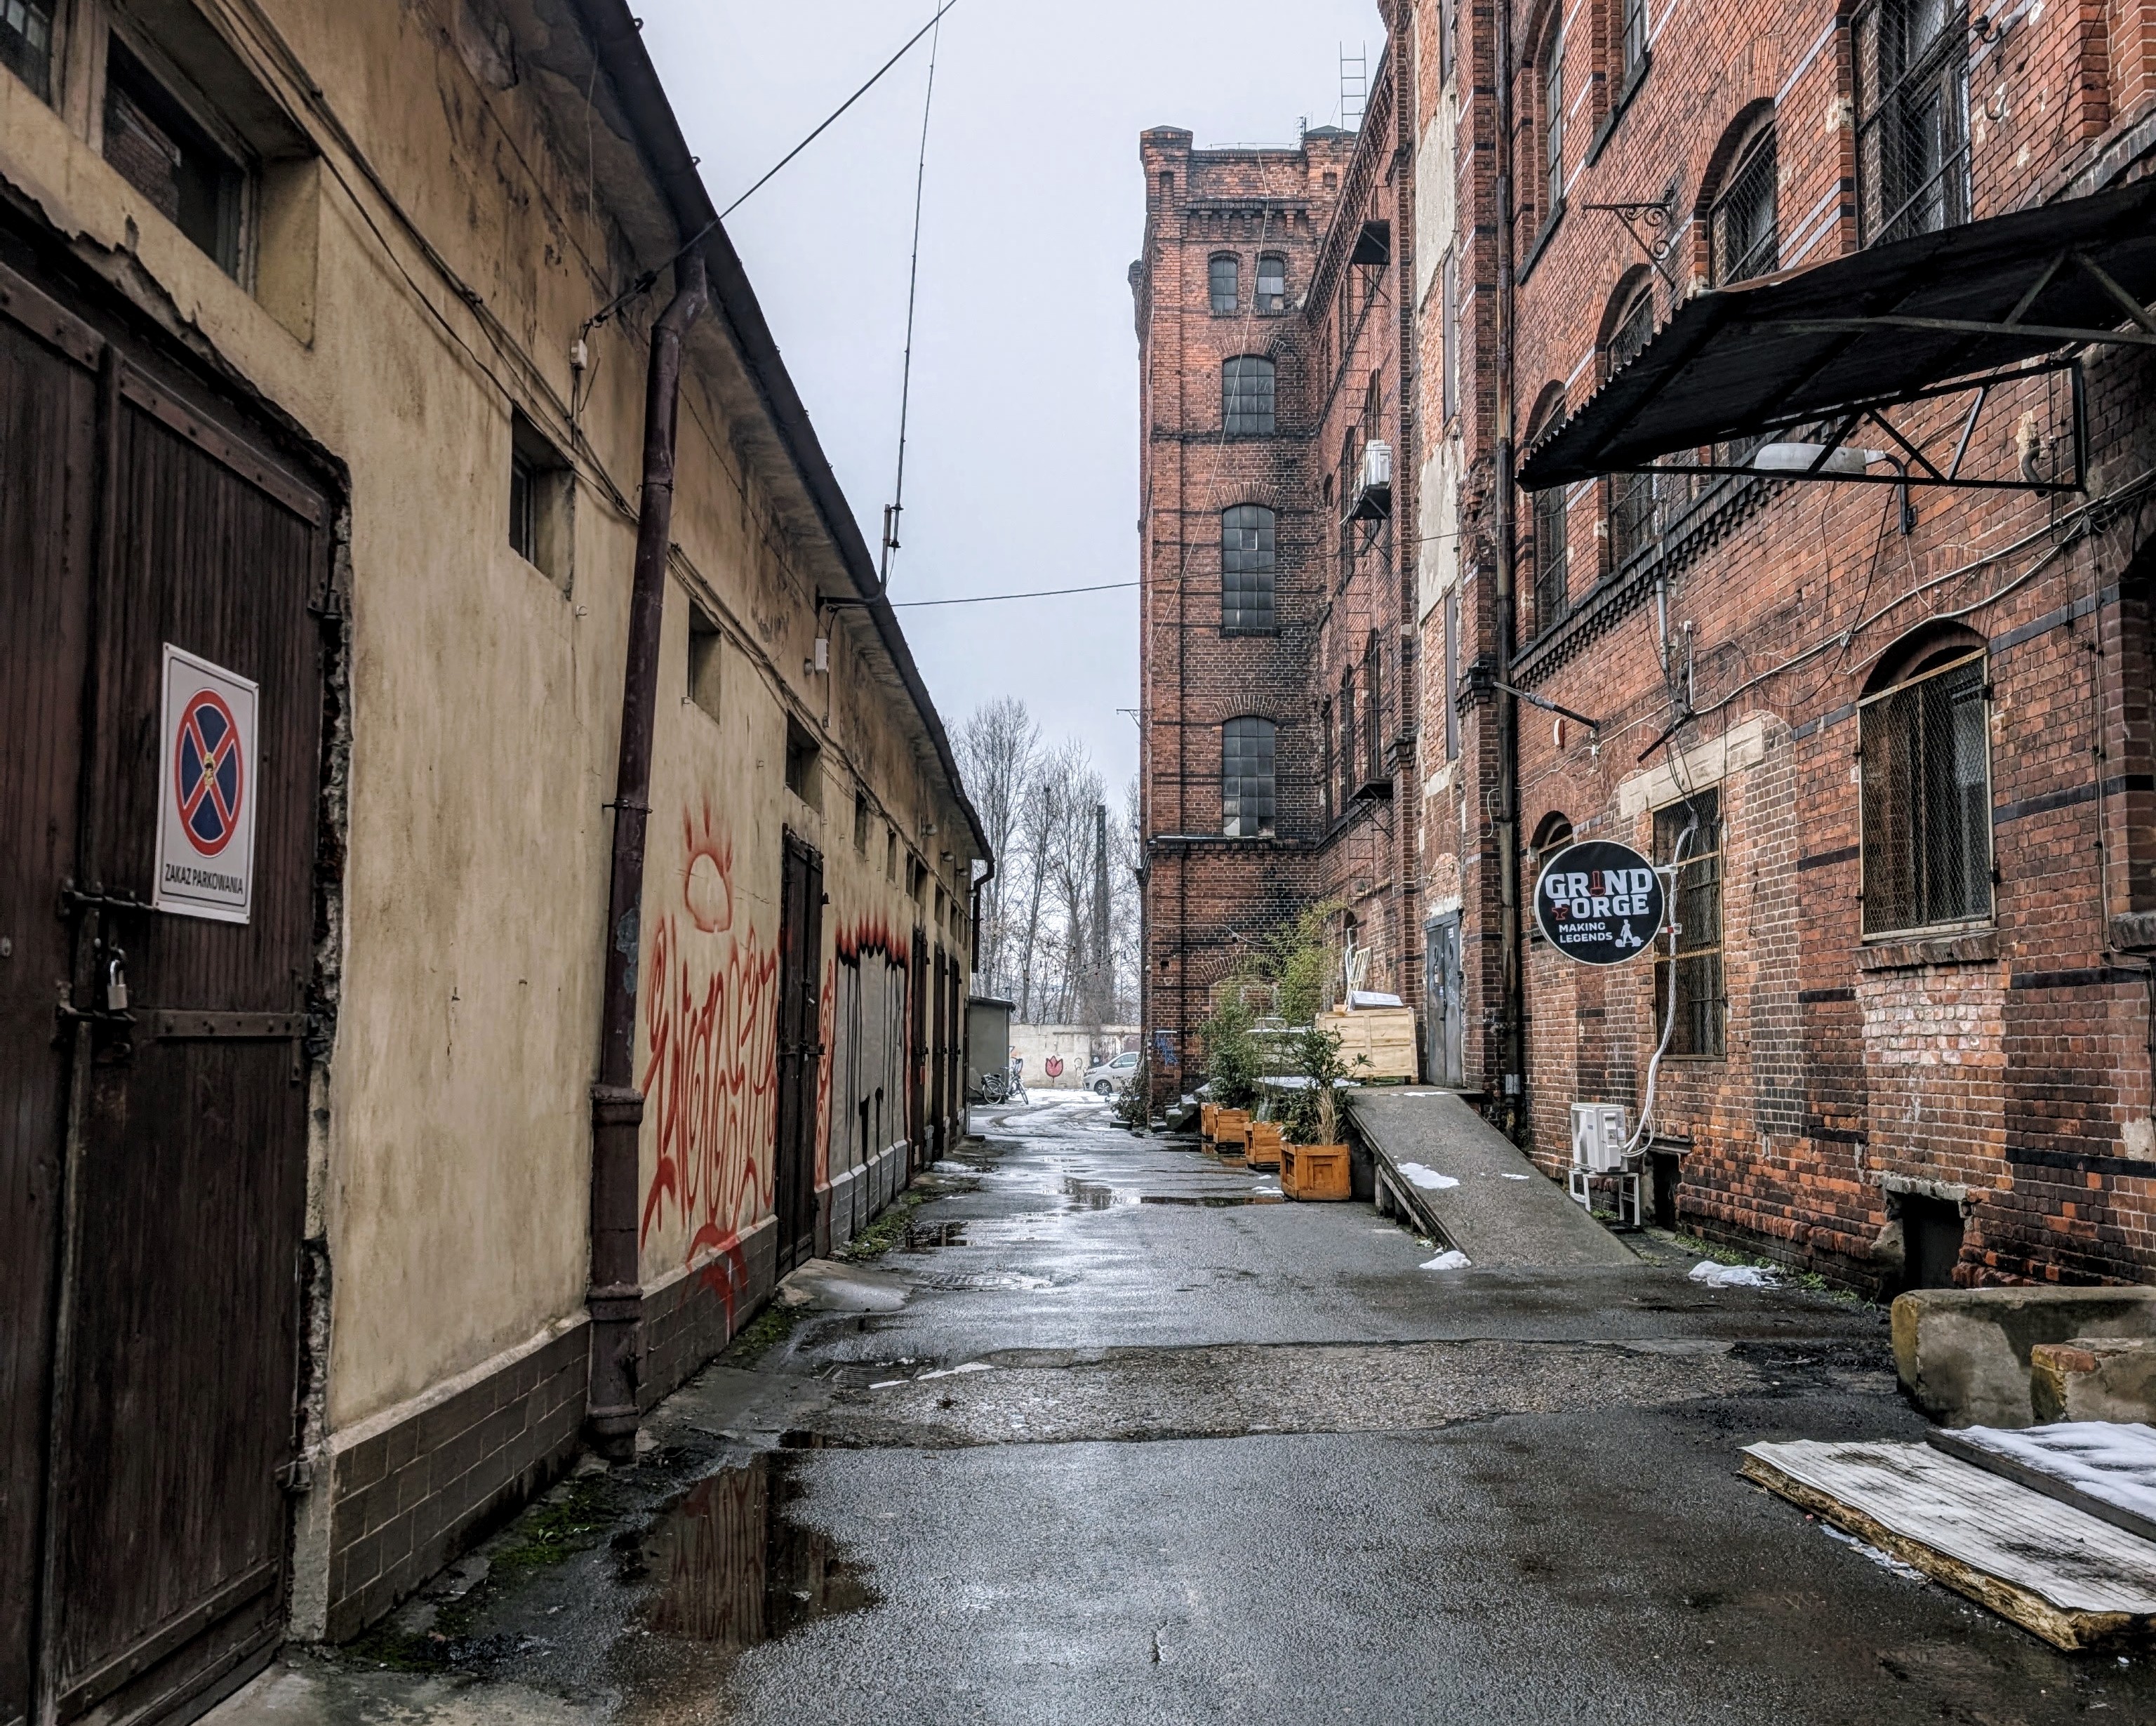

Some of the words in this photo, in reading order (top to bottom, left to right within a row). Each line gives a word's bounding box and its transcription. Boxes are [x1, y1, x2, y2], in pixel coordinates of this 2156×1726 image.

[166, 863, 191, 884] ZAKAZ
[192, 869, 243, 894] PARKOWANIA
[1545, 868, 1653, 899] GRIND
[1552, 894, 1649, 920] FORGE
[1559, 922, 1606, 933] MAKING
[1559, 931, 1613, 943] LEGENDS
